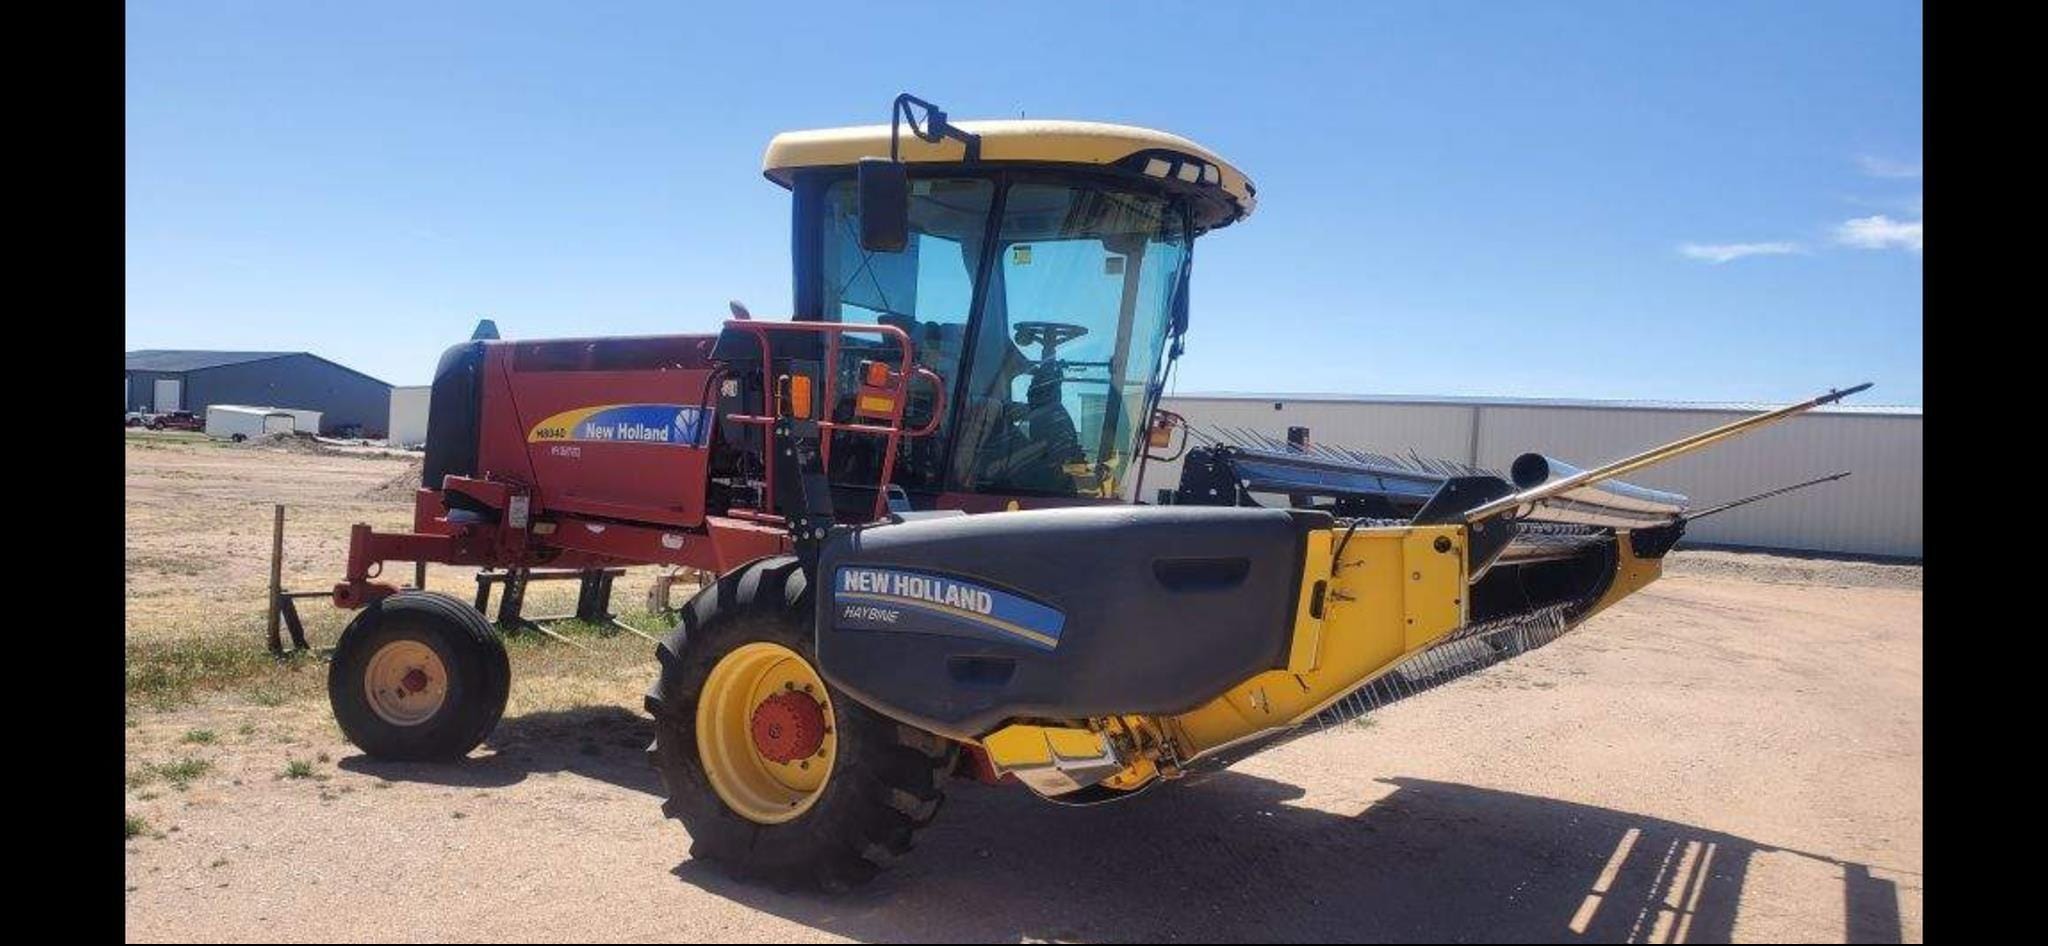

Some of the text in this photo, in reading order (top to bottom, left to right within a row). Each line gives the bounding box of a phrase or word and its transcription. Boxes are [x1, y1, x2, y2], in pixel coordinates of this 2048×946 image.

[586, 422, 669, 441] New Holland
[844, 570, 993, 615] NEW HOLLAND
[844, 605, 899, 624] HAYBINE
